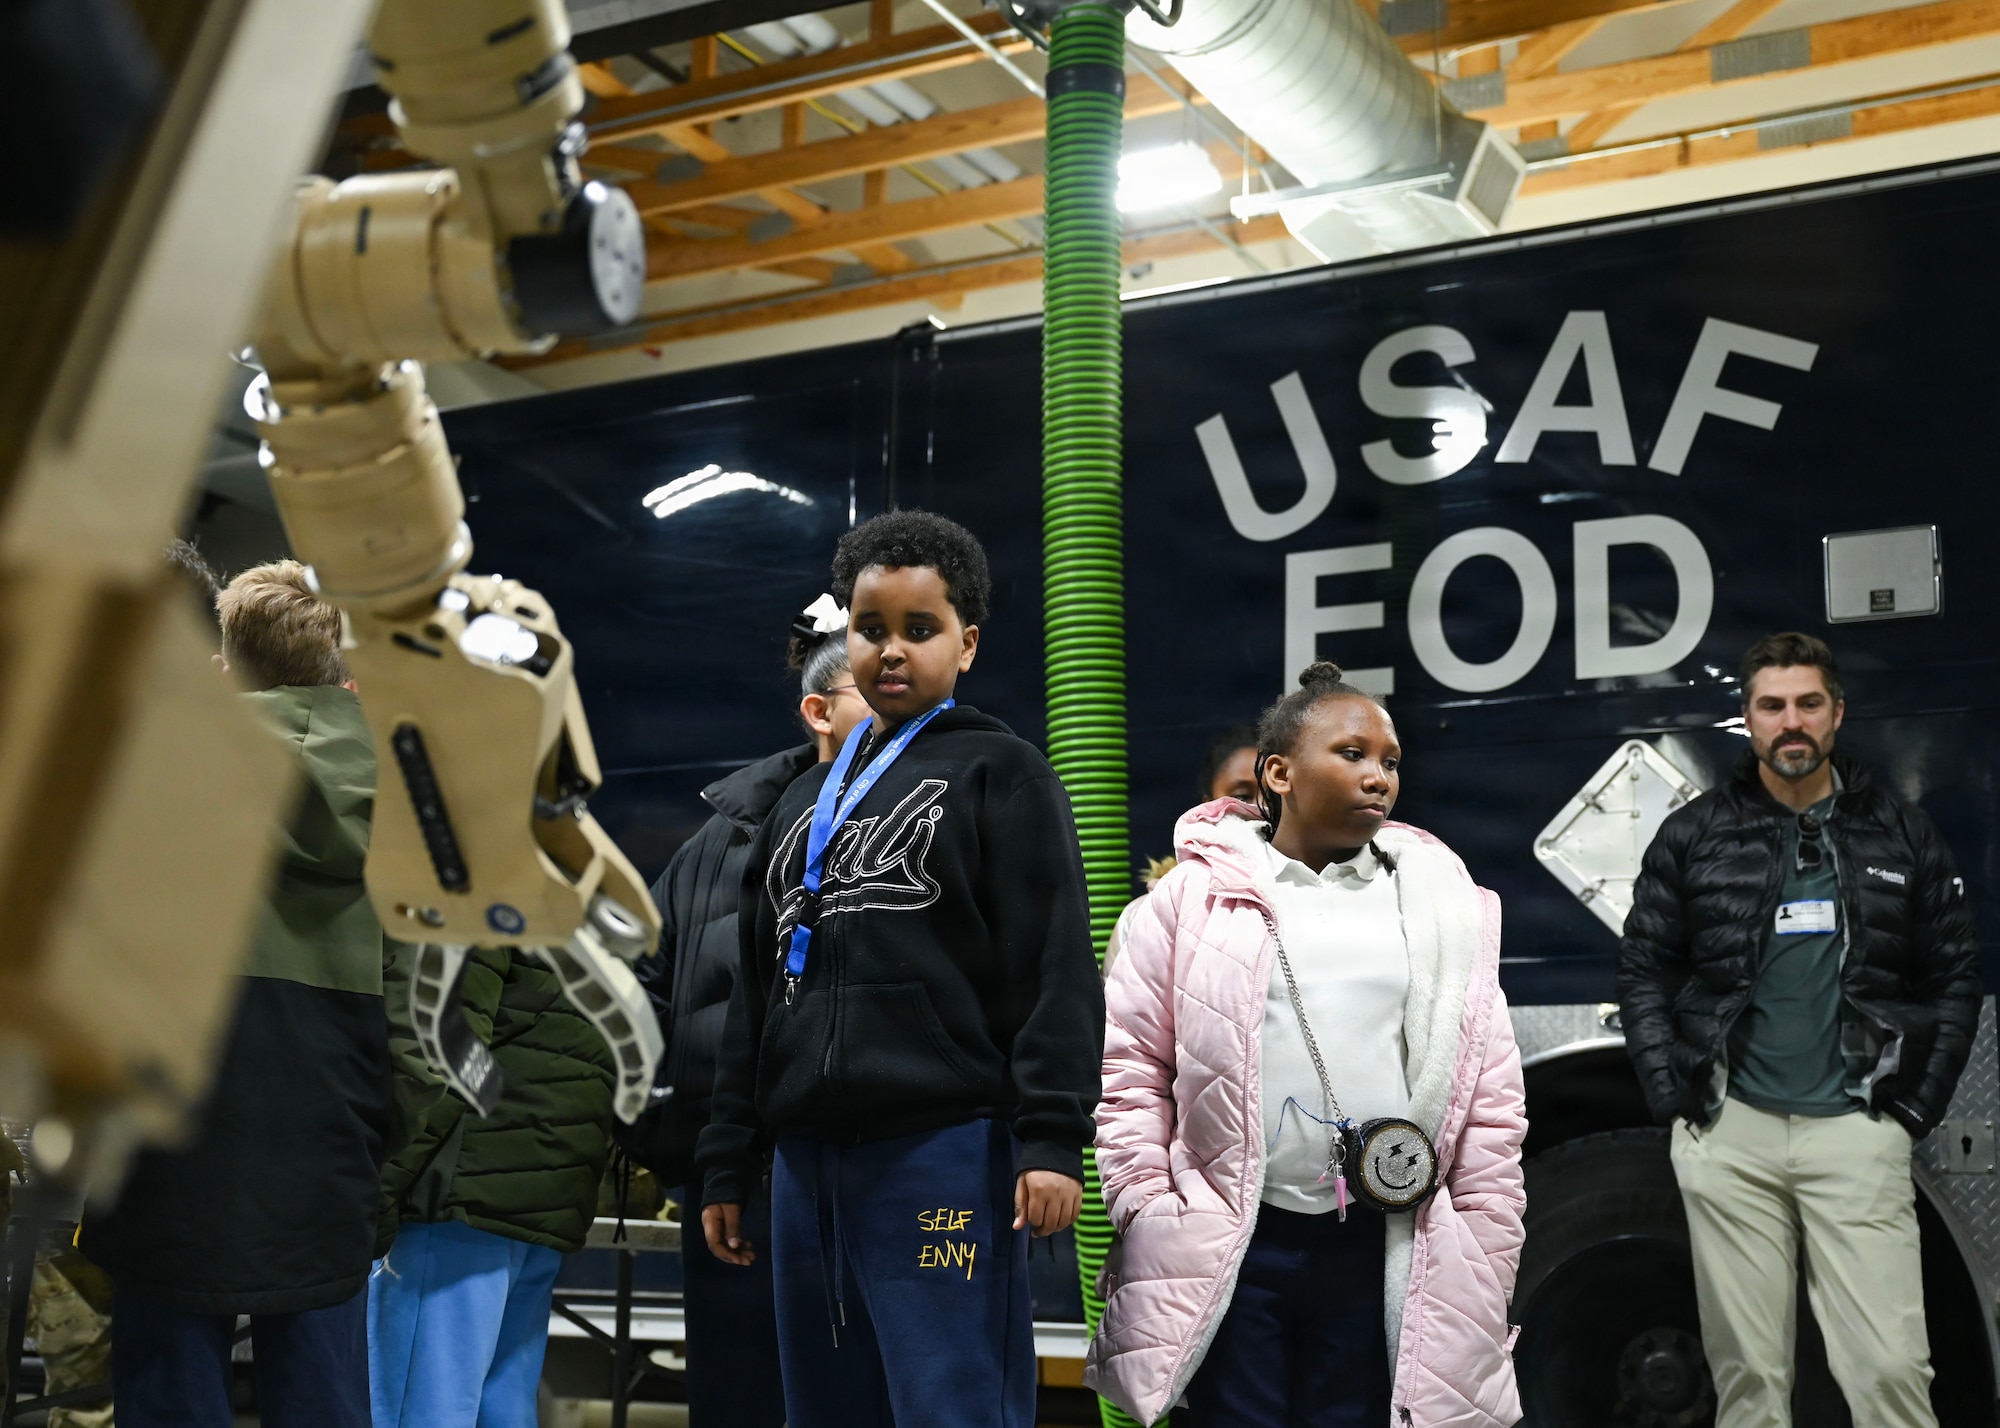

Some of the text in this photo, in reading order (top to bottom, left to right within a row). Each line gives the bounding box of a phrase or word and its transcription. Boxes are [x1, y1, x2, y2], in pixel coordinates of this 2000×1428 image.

[1195, 310, 1819, 542] USAF
[1285, 514, 1714, 694] EOD
[877, 749, 896, 767] Center
[856, 779, 870, 791] City
[917, 1207, 974, 1231] SELF
[917, 1239, 976, 1281] ENVY
